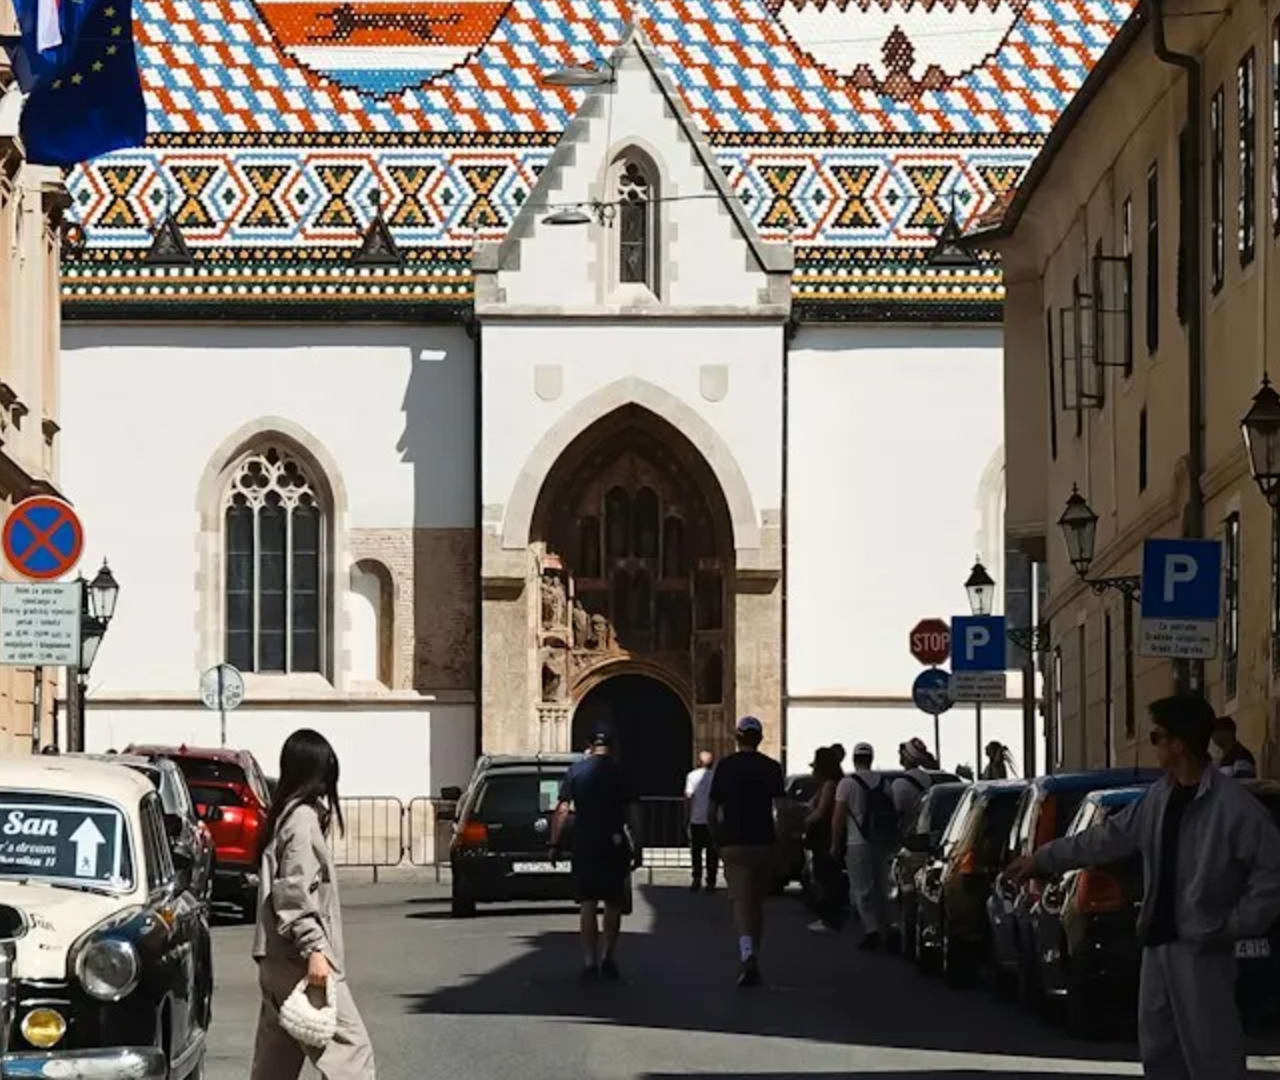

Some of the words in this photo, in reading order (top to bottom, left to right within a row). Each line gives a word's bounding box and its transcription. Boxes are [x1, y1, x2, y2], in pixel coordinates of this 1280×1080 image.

[1163, 553, 1198, 603] P
[913, 632, 950, 652] STOP
[965, 625, 991, 660] P
[2, 811, 58, 837] San
[15, 841, 56, 854] dream
